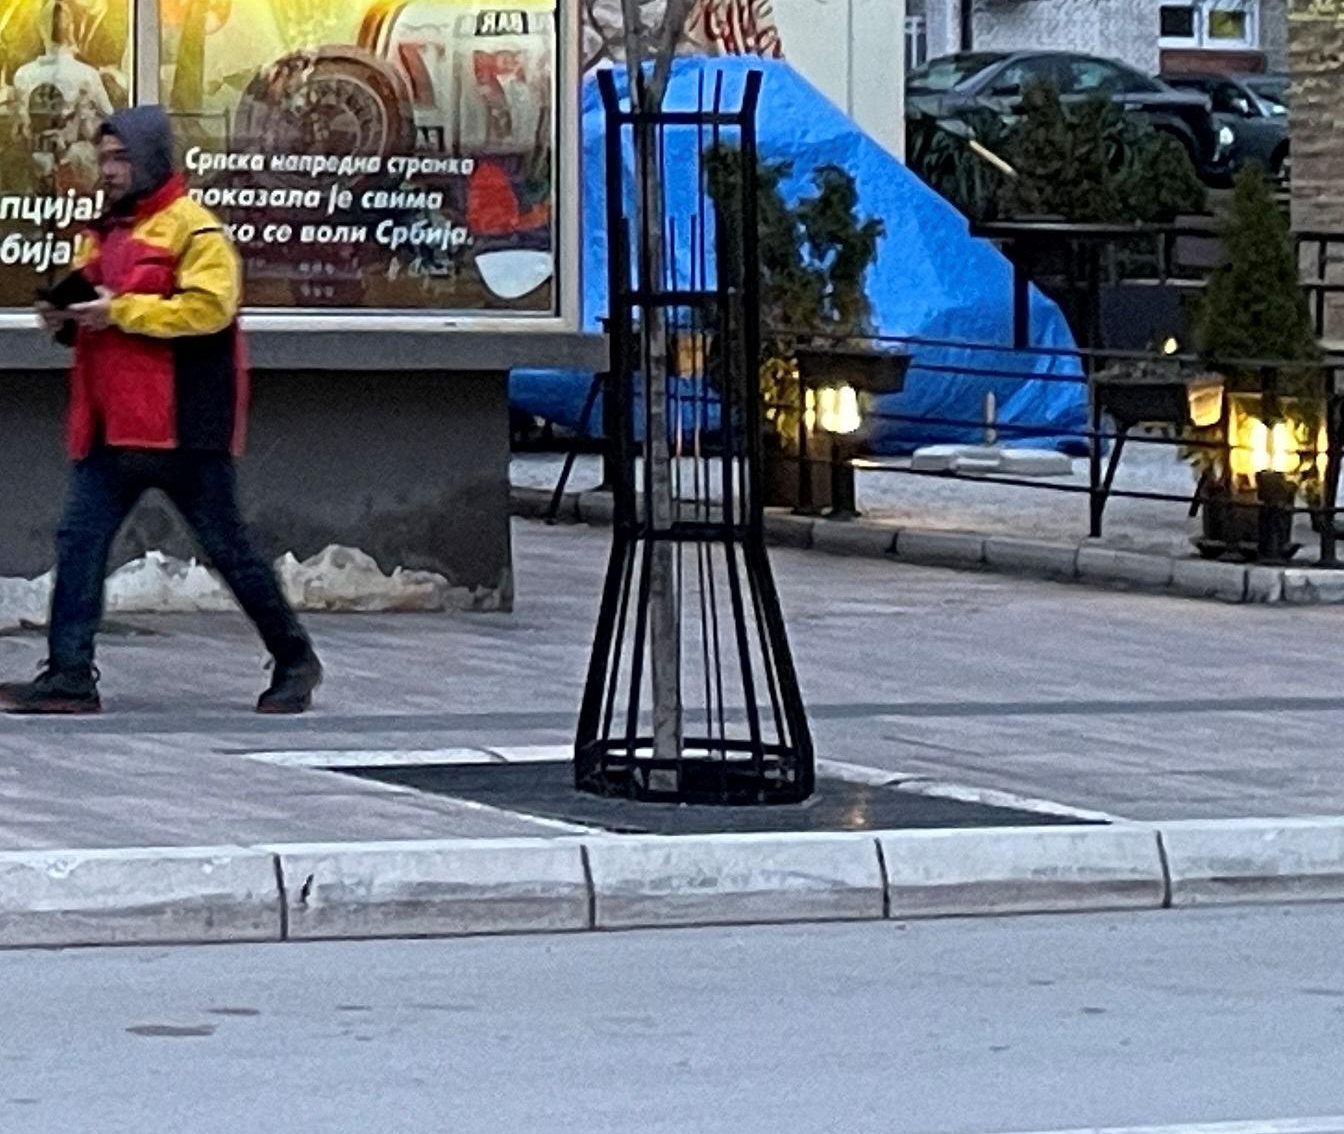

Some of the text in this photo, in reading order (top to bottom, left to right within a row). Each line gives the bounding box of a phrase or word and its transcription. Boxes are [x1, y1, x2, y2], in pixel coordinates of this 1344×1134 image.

[185, 146, 475, 179] Српска напредна странка
[187, 183, 444, 215] показала је свима
[262, 223, 293, 243] се
[299, 224, 367, 244] воли
[375, 218, 474, 250] Србија.
